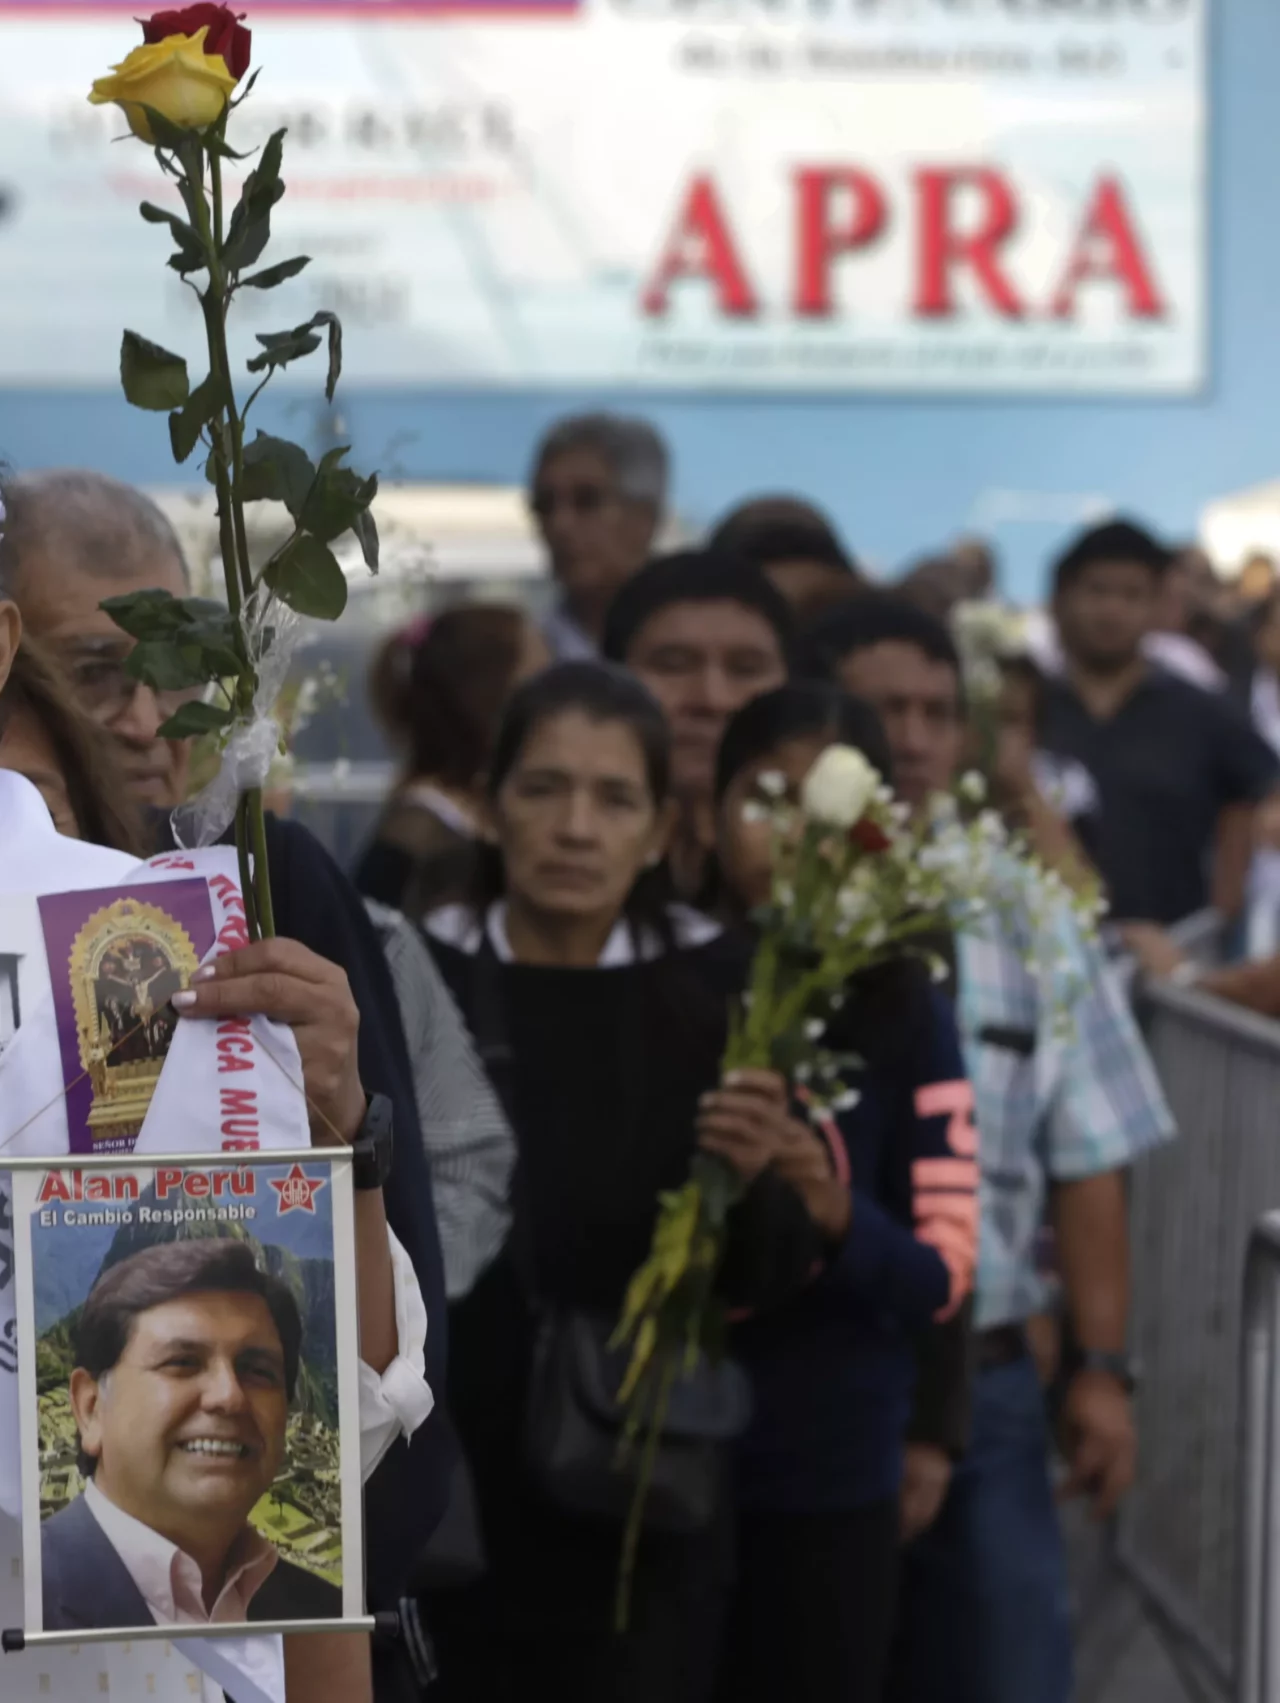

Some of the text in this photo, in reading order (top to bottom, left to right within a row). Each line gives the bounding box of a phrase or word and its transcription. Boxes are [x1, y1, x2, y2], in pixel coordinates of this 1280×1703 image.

[641, 162, 1169, 322] APRA
[38, 1162, 256, 1201] Alan Perú
[39, 1202, 257, 1227] El Cambio Responsable
